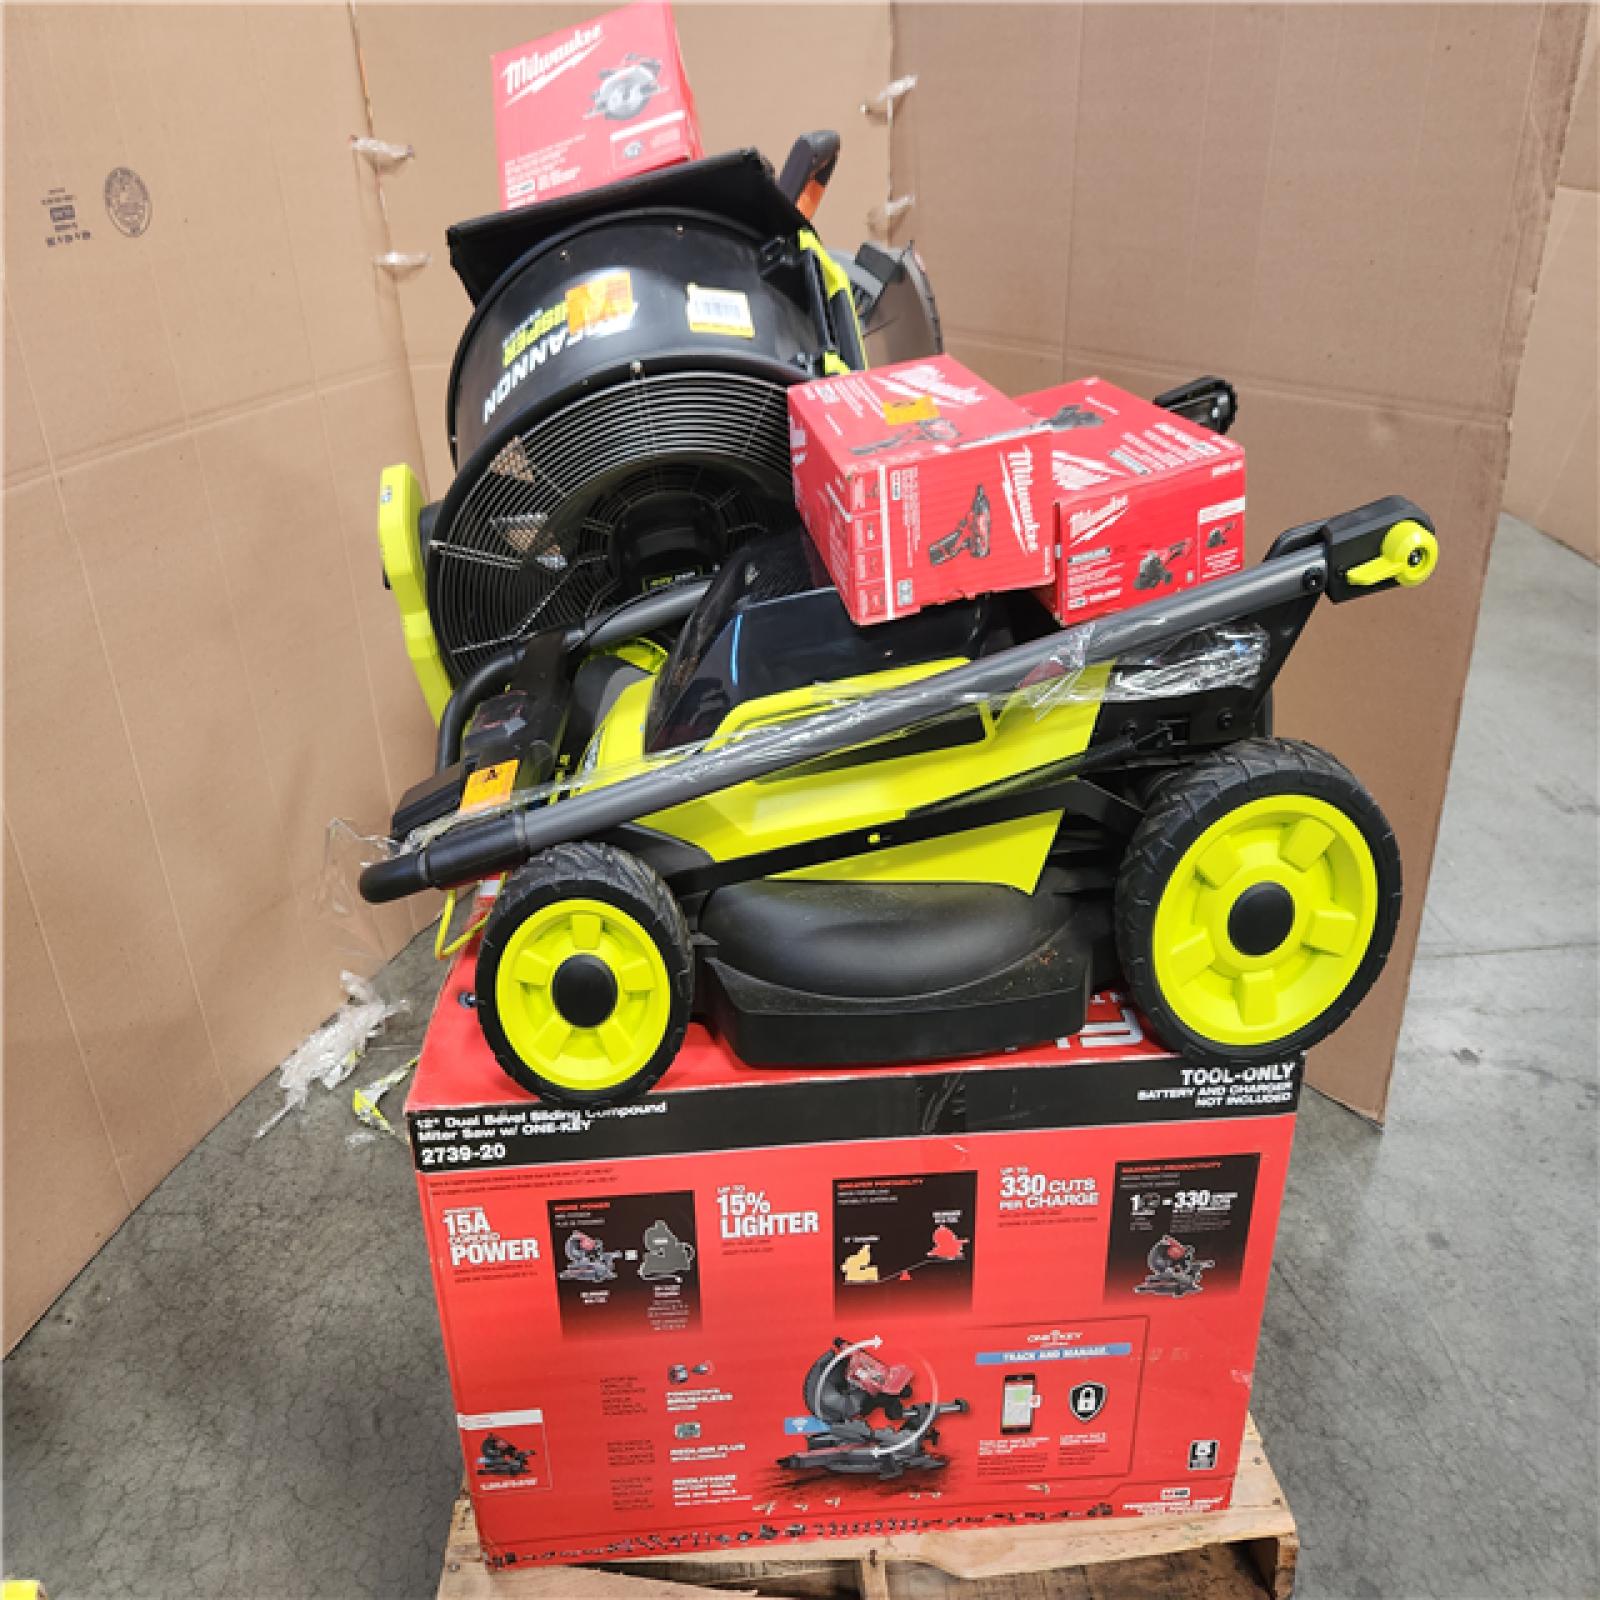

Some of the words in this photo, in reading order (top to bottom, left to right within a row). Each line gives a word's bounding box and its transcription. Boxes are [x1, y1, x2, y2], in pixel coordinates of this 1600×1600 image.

[501, 24, 602, 96] Milwaukee
[1007, 444, 1040, 552] Milwaukee
[1181, 1062, 1296, 1086] TOOL-ONLY
[1137, 1088, 1195, 1101] BATTERY
[1197, 1085, 1226, 1096] AND
[1229, 1081, 1293, 1094] CHARGER
[1195, 1097, 1223, 1108] NOT
[1225, 1092, 1293, 1106] INCLUDED
[417, 1129, 458, 1142] Miter
[462, 1127, 496, 1139] Saw
[521, 1119, 591, 1135] ONE-KEY
[445, 1114, 481, 1128] Dual
[484, 1110, 526, 1126] Bevel
[421, 1142, 506, 1166] 2739-20
[1000, 1173, 1046, 1197] 330
[1050, 1178, 1096, 1193] CUTS
[716, 1190, 771, 1216] 15%
[1026, 1192, 1099, 1208] CHARGE
[1174, 1190, 1211, 1208] 330
[442, 1211, 491, 1237] 15A
[721, 1211, 819, 1239] LIGHTER
[450, 1238, 541, 1266] POWER
